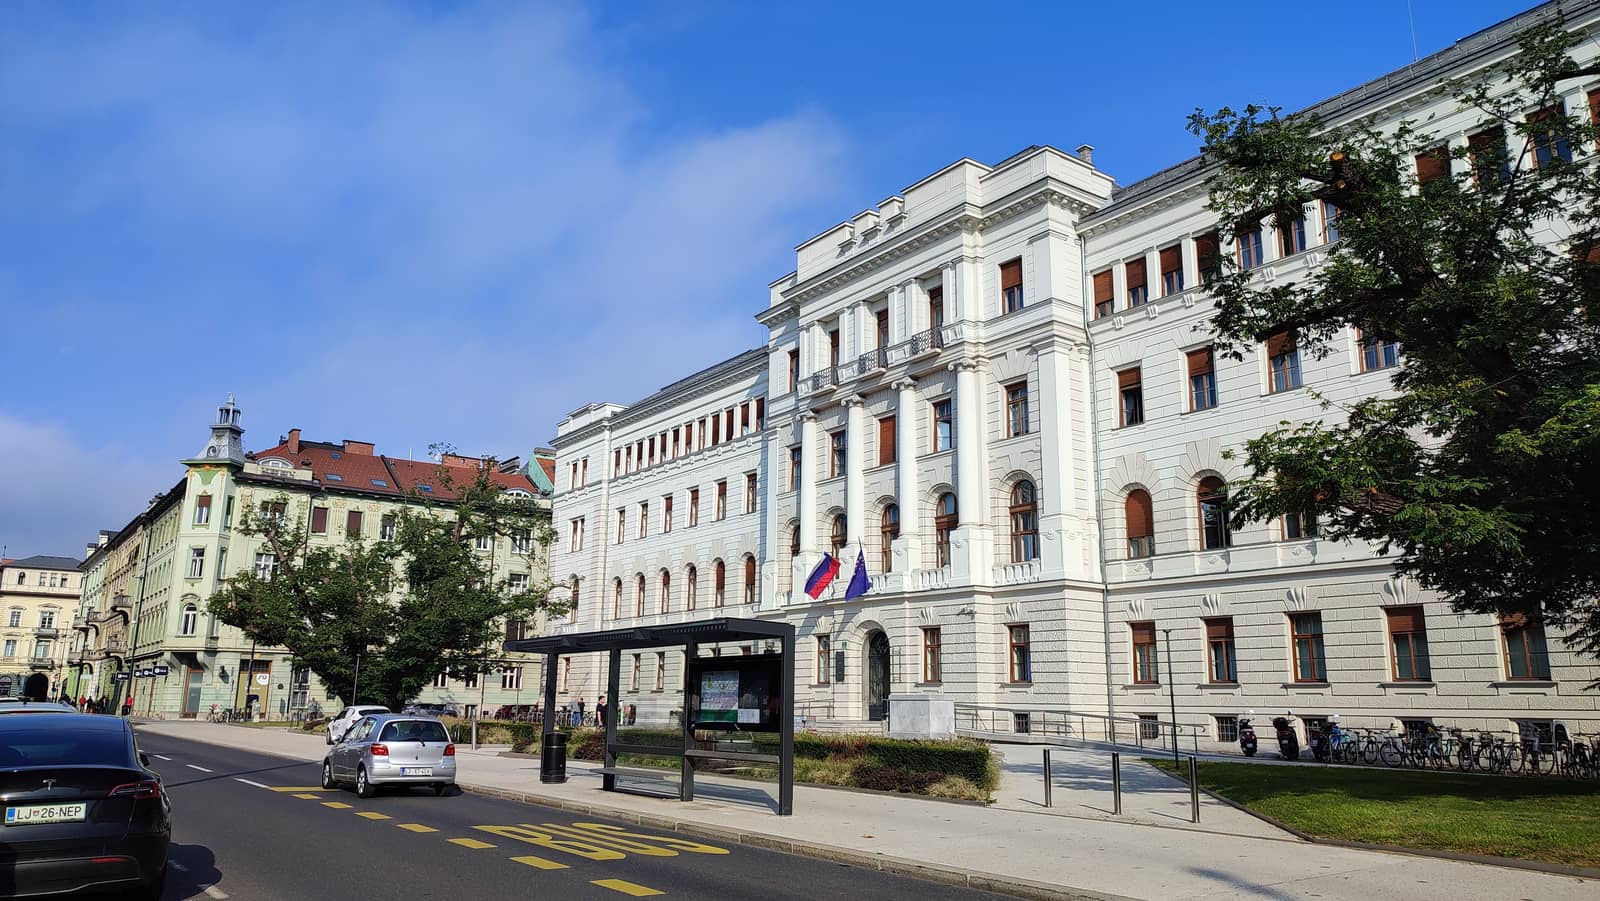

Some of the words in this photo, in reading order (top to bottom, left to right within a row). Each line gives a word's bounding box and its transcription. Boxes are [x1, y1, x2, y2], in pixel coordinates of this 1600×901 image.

[17, 808, 32, 820] LJ
[41, 806, 82, 819] 26-NEP
[469, 822, 730, 861] BUS
